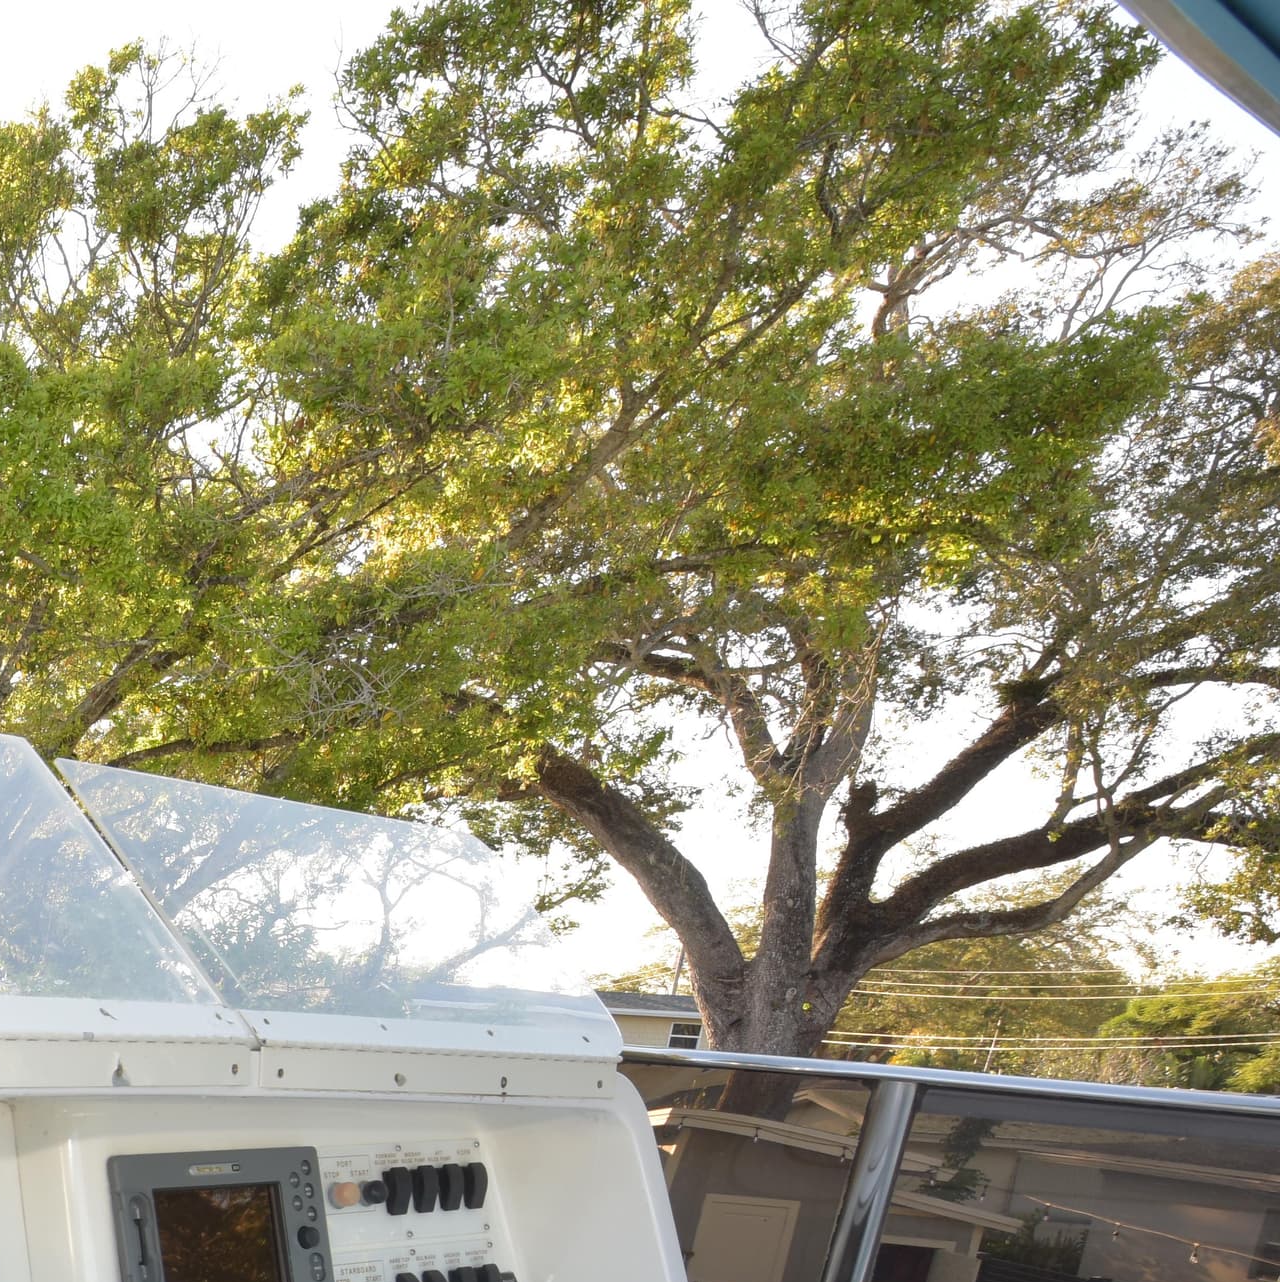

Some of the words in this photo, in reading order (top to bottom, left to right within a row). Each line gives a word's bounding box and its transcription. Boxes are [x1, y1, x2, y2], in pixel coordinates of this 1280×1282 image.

[336, 1160, 352, 1168] PORT
[324, 1170, 340, 1179] STOP
[350, 1168, 370, 1177] START
[340, 1265, 377, 1276] STARBOARD
[365, 1274, 383, 1282] START
